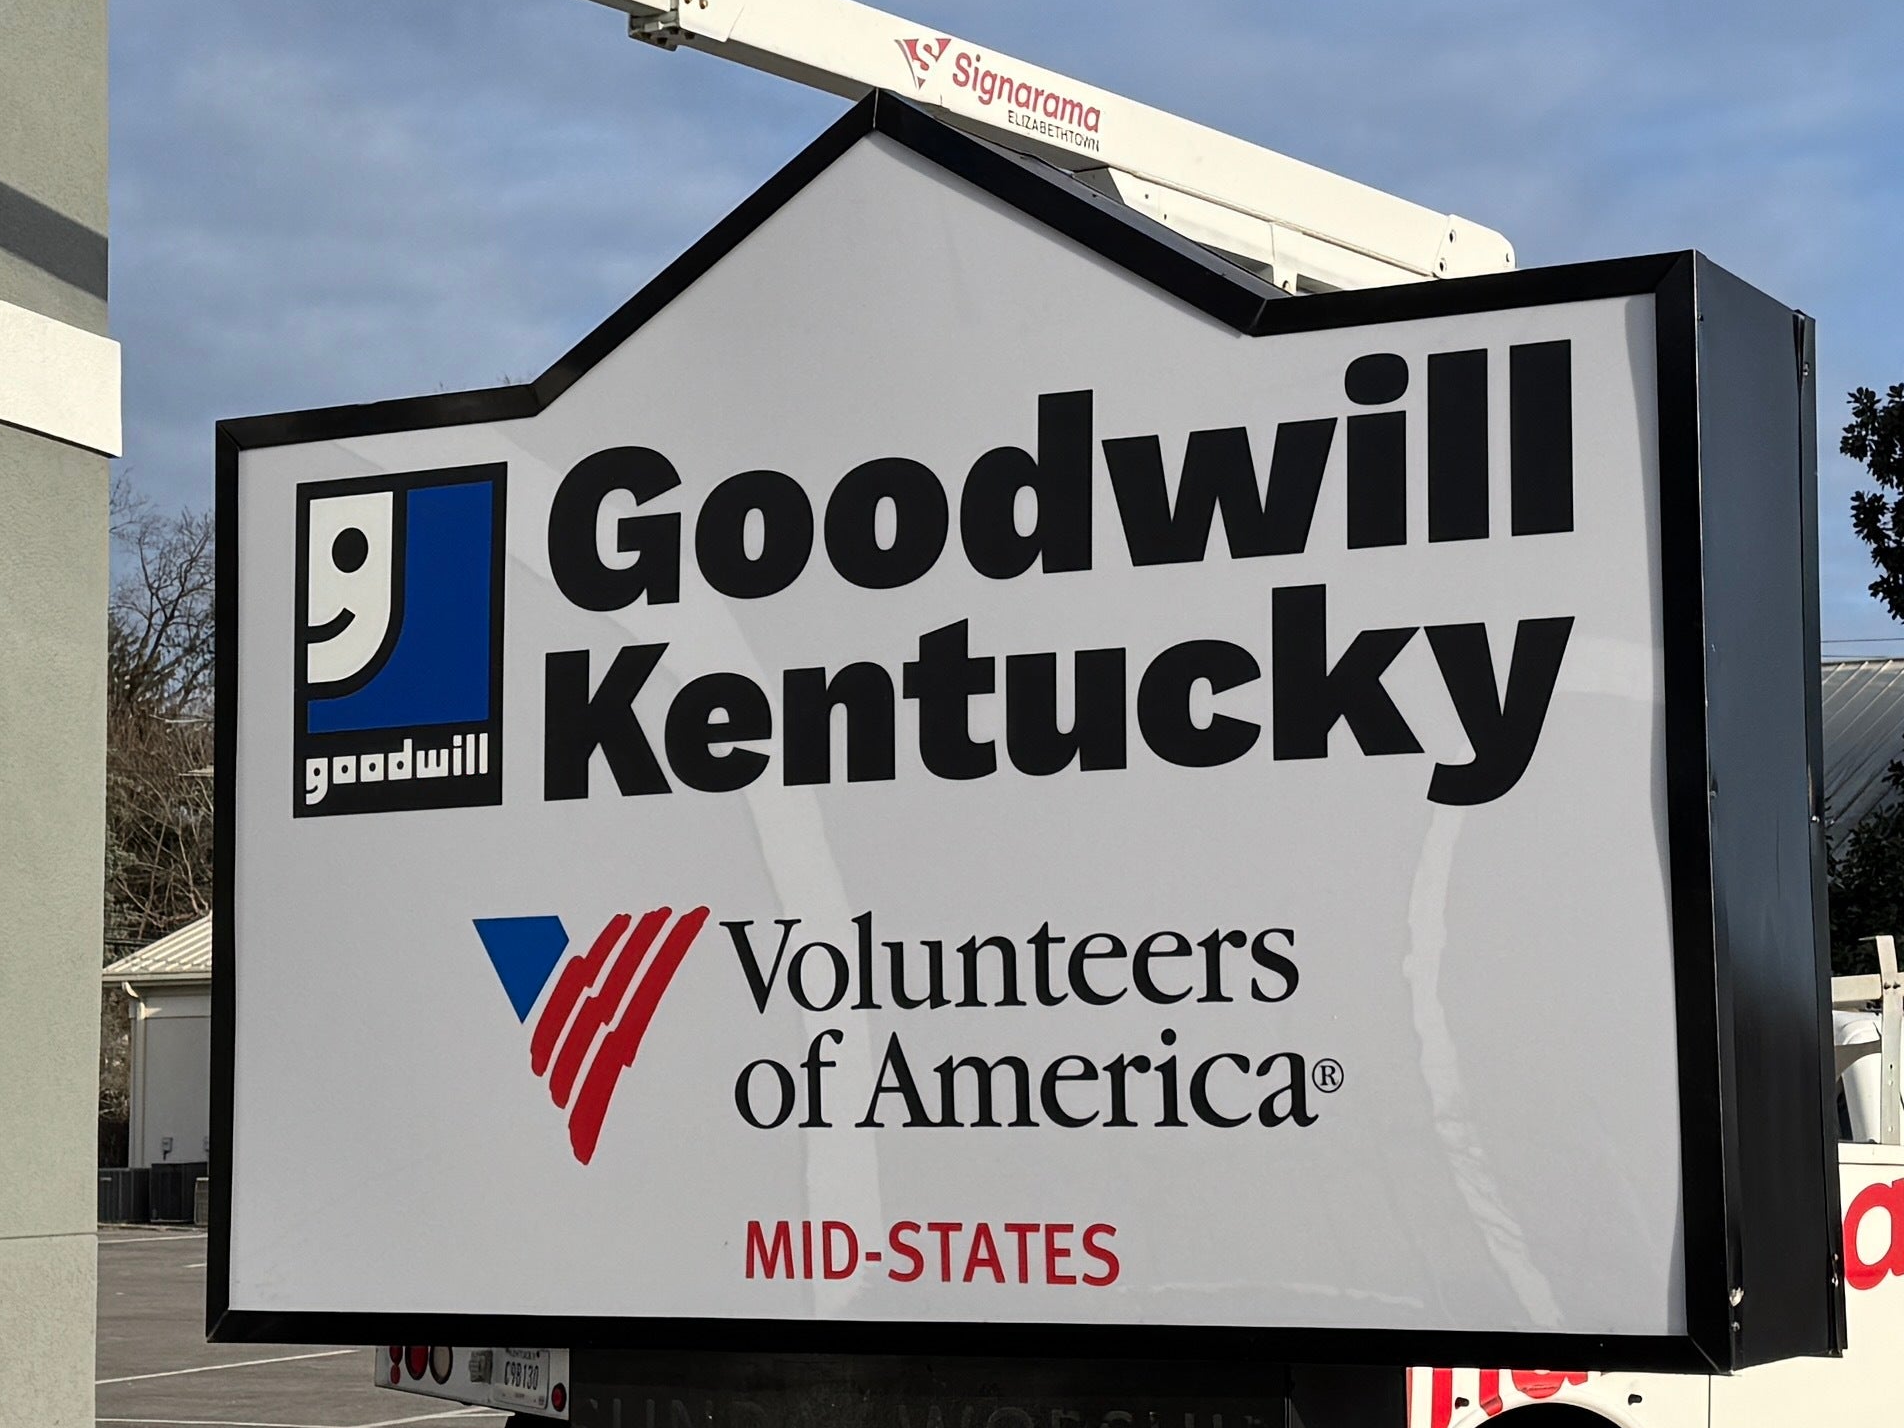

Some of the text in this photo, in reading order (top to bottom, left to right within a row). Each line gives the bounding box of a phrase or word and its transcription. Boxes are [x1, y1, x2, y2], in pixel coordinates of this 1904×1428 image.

[952, 52, 1101, 134] Signarama
[1007, 109, 1100, 153] ELIZABETHTOWN
[547, 338, 1575, 612] Goodwill
[543, 583, 1576, 806] Kentucky
[305, 732, 489, 806] goodwill
[719, 910, 1299, 1014] Volunteers
[733, 1028, 844, 1129] of
[745, 1220, 1121, 1287] MID-STATES
